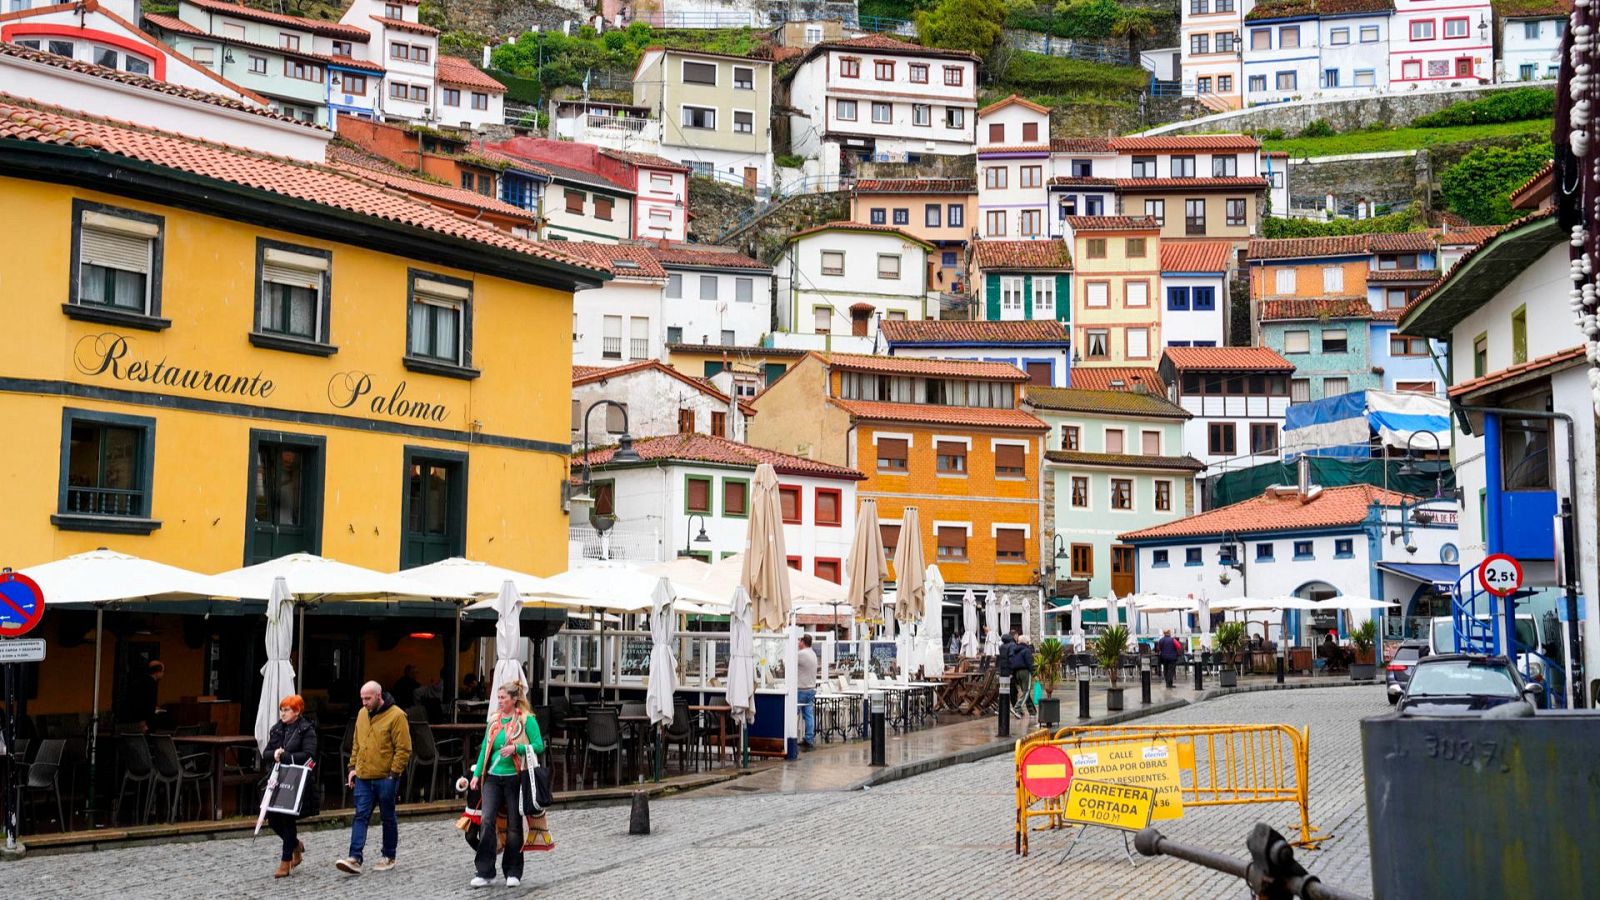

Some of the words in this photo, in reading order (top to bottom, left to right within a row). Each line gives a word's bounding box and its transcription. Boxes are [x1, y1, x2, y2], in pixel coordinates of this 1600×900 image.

[74, 332, 276, 399] Restaurante
[328, 371, 451, 422] Paloma
[1109, 750, 1134, 760] CALLE
[1078, 763, 1118, 775] CORTADA
[1119, 762, 1137, 771] POR
[1139, 760, 1168, 769] OBRAS
[1074, 782, 1148, 801] CARRETERA
[1078, 797, 1138, 815] CORTADA
